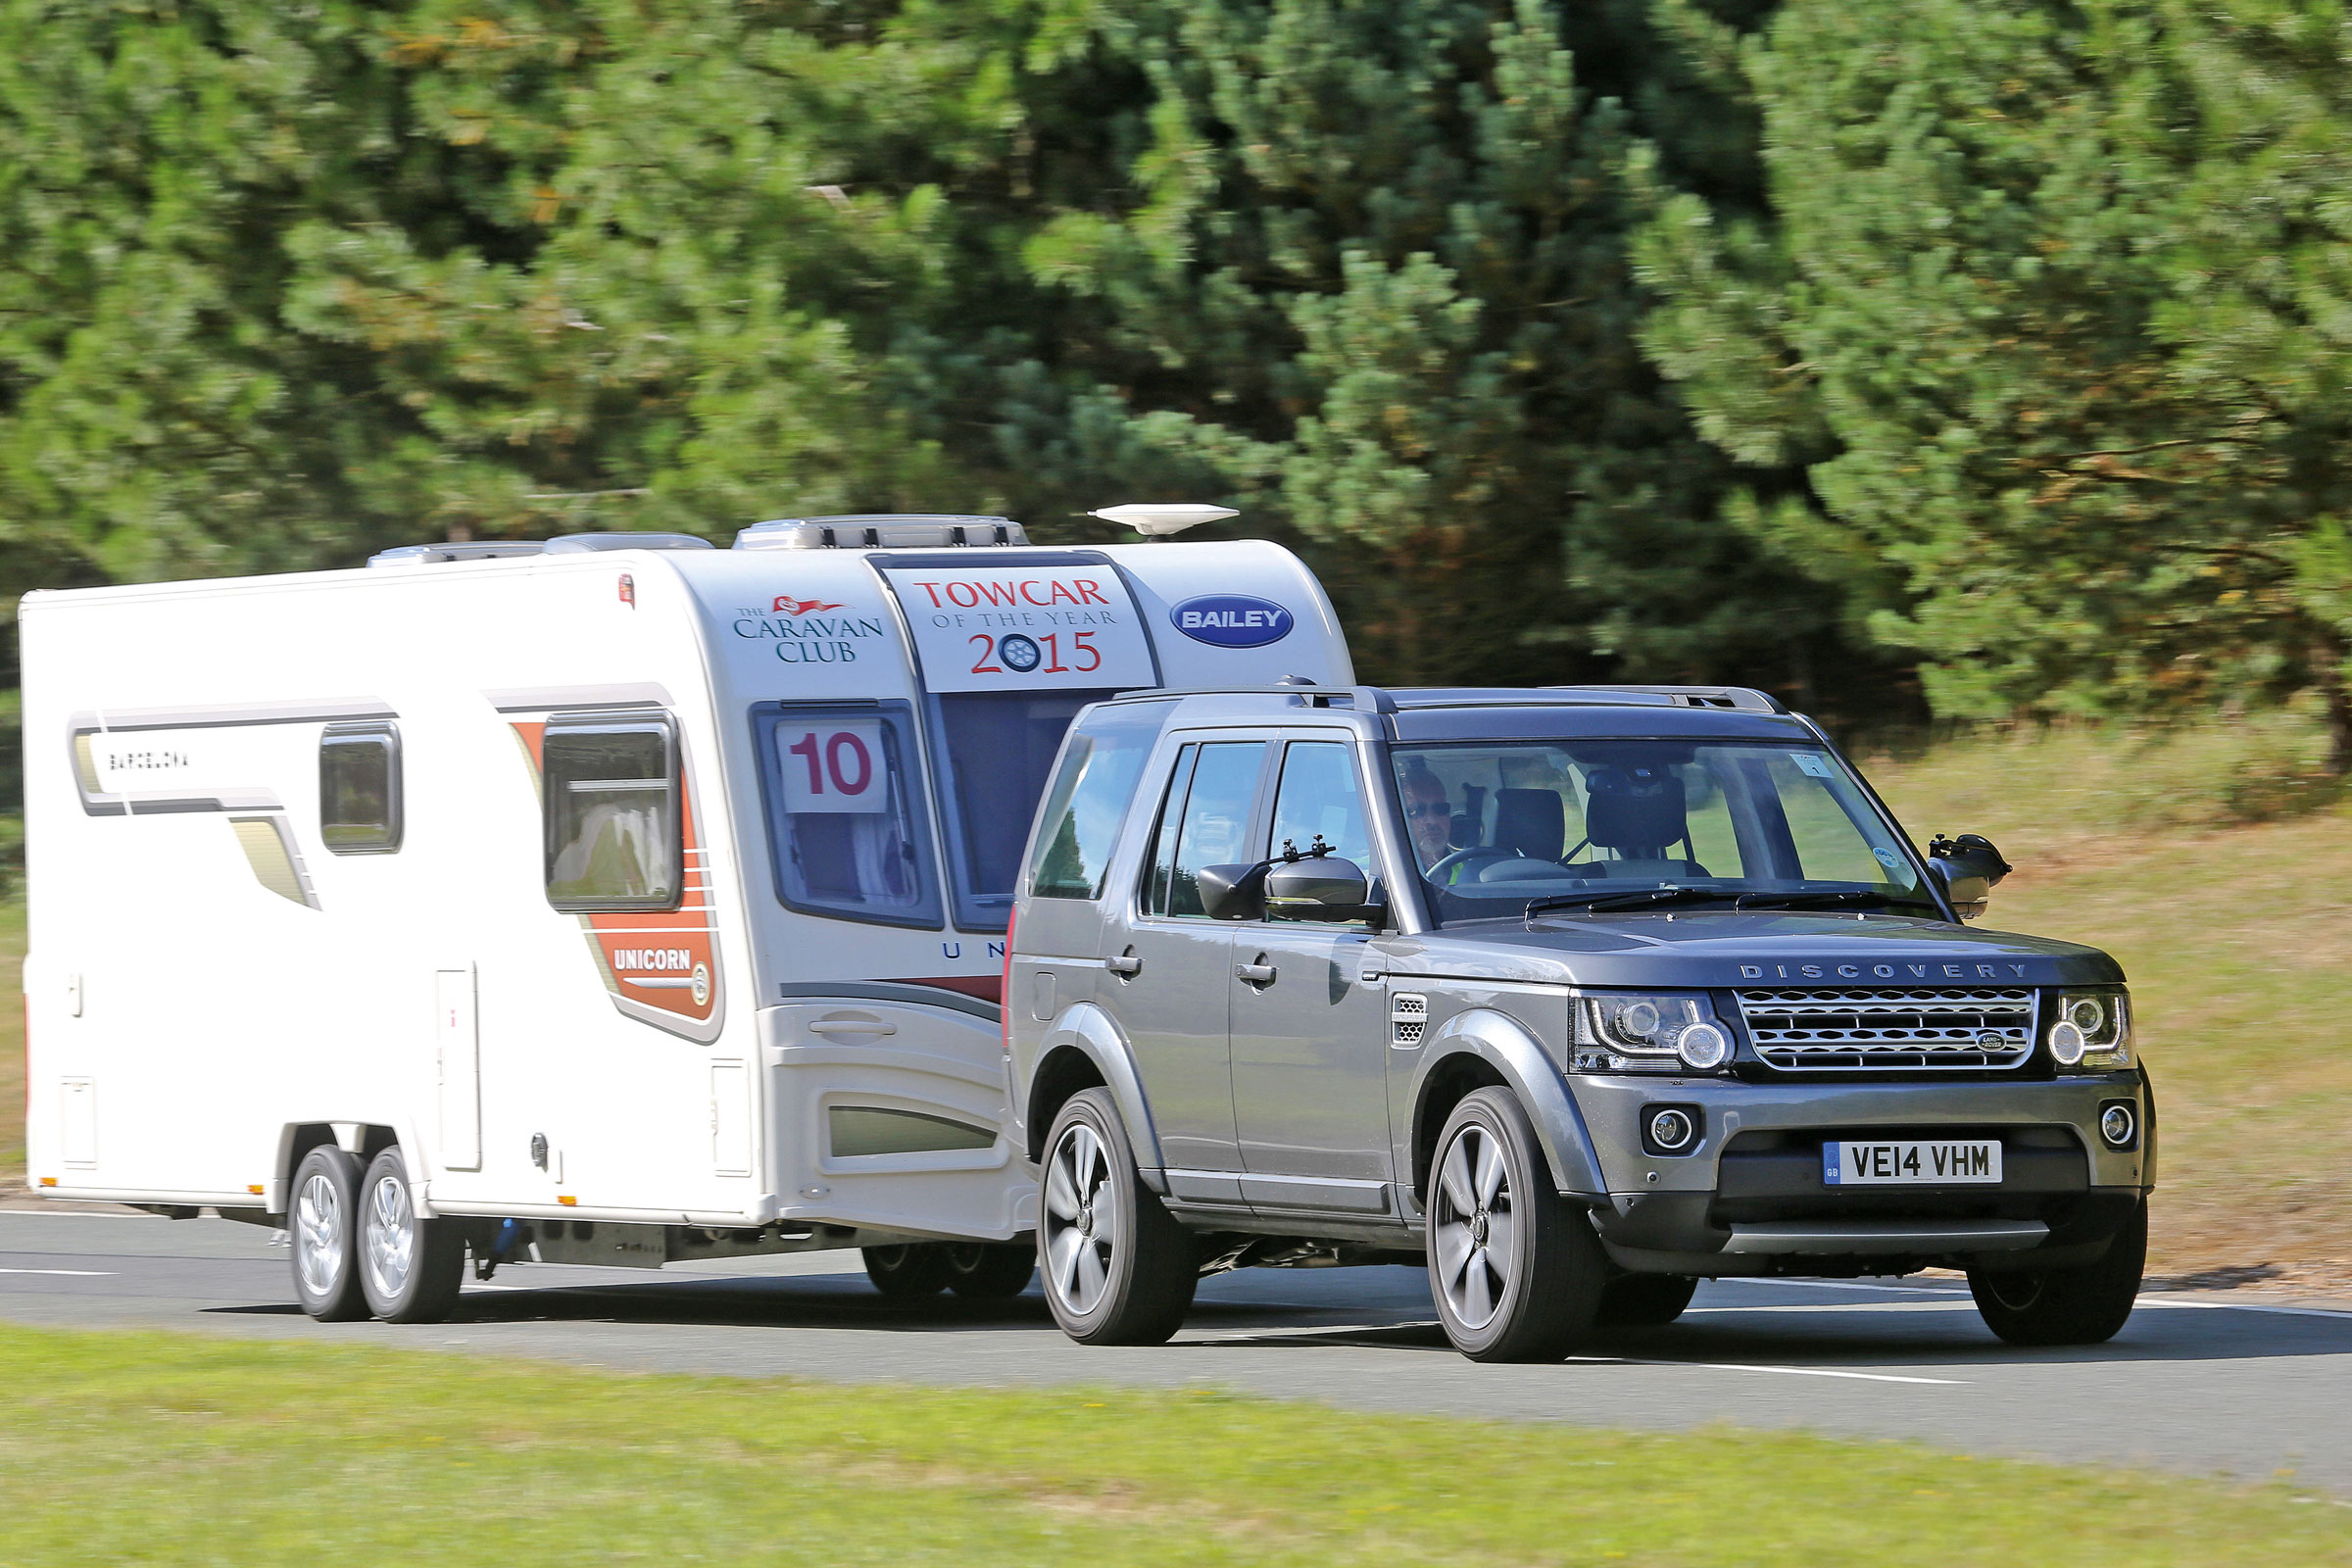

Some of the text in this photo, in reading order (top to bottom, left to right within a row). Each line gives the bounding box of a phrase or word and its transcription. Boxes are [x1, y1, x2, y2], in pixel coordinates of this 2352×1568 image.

[912, 579, 1110, 609] TOWCAR
[736, 608, 766, 616] THE
[932, 611, 1117, 628] OF THE YEAR
[1182, 610, 1283, 628] BAILEY
[733, 617, 884, 639] CARAVAN
[776, 641, 857, 662] CLUB
[968, 630, 1102, 674] 2015
[110, 751, 189, 770] BARCELONA
[790, 732, 871, 796] 10
[613, 949, 691, 970] UNICORN
[1740, 963, 2026, 979] DISCOVERY
[1851, 1145, 1989, 1177] VE14 VHM
[1827, 1168, 1838, 1177] GB
